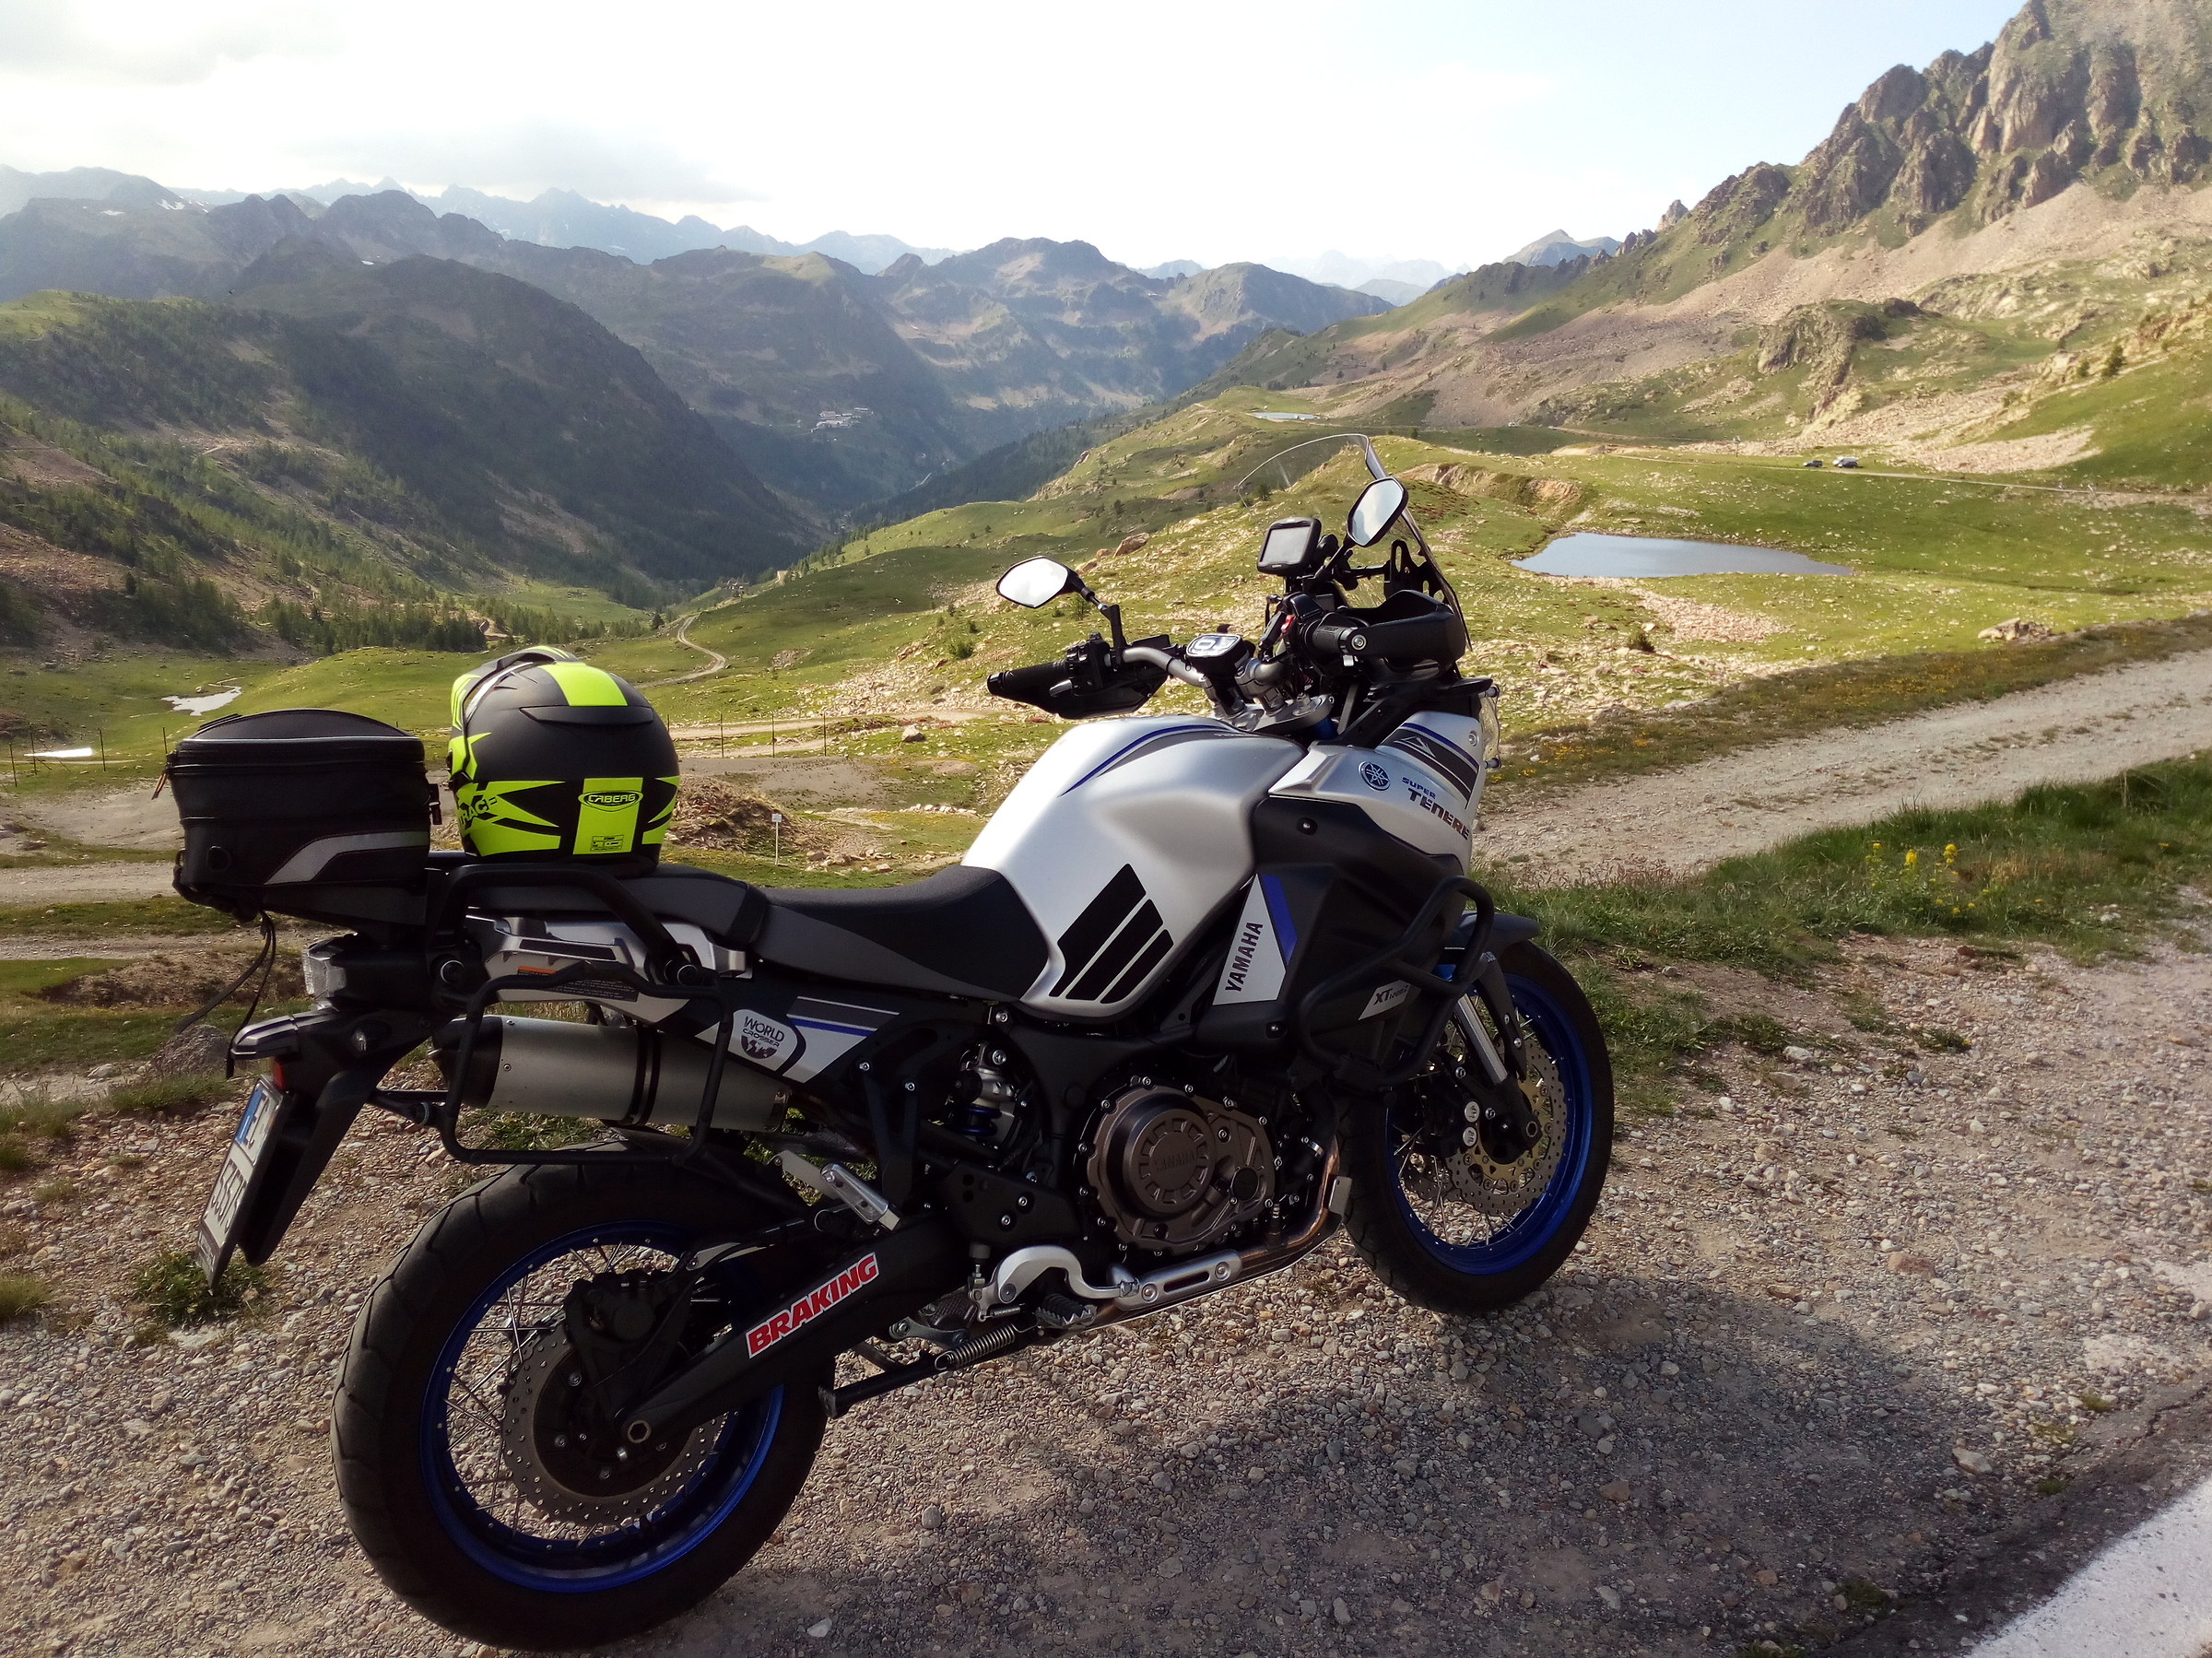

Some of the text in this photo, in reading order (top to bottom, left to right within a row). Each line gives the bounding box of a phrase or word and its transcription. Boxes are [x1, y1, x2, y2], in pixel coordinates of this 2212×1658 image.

[588, 794, 636, 804] CABERG
[1401, 777, 1436, 799] SUPER
[1224, 922, 1264, 993] YAMAHA
[742, 1028, 780, 1048] CROSSER
[744, 1016, 785, 1042] WORLD
[747, 1253, 878, 1357] BRAKING
